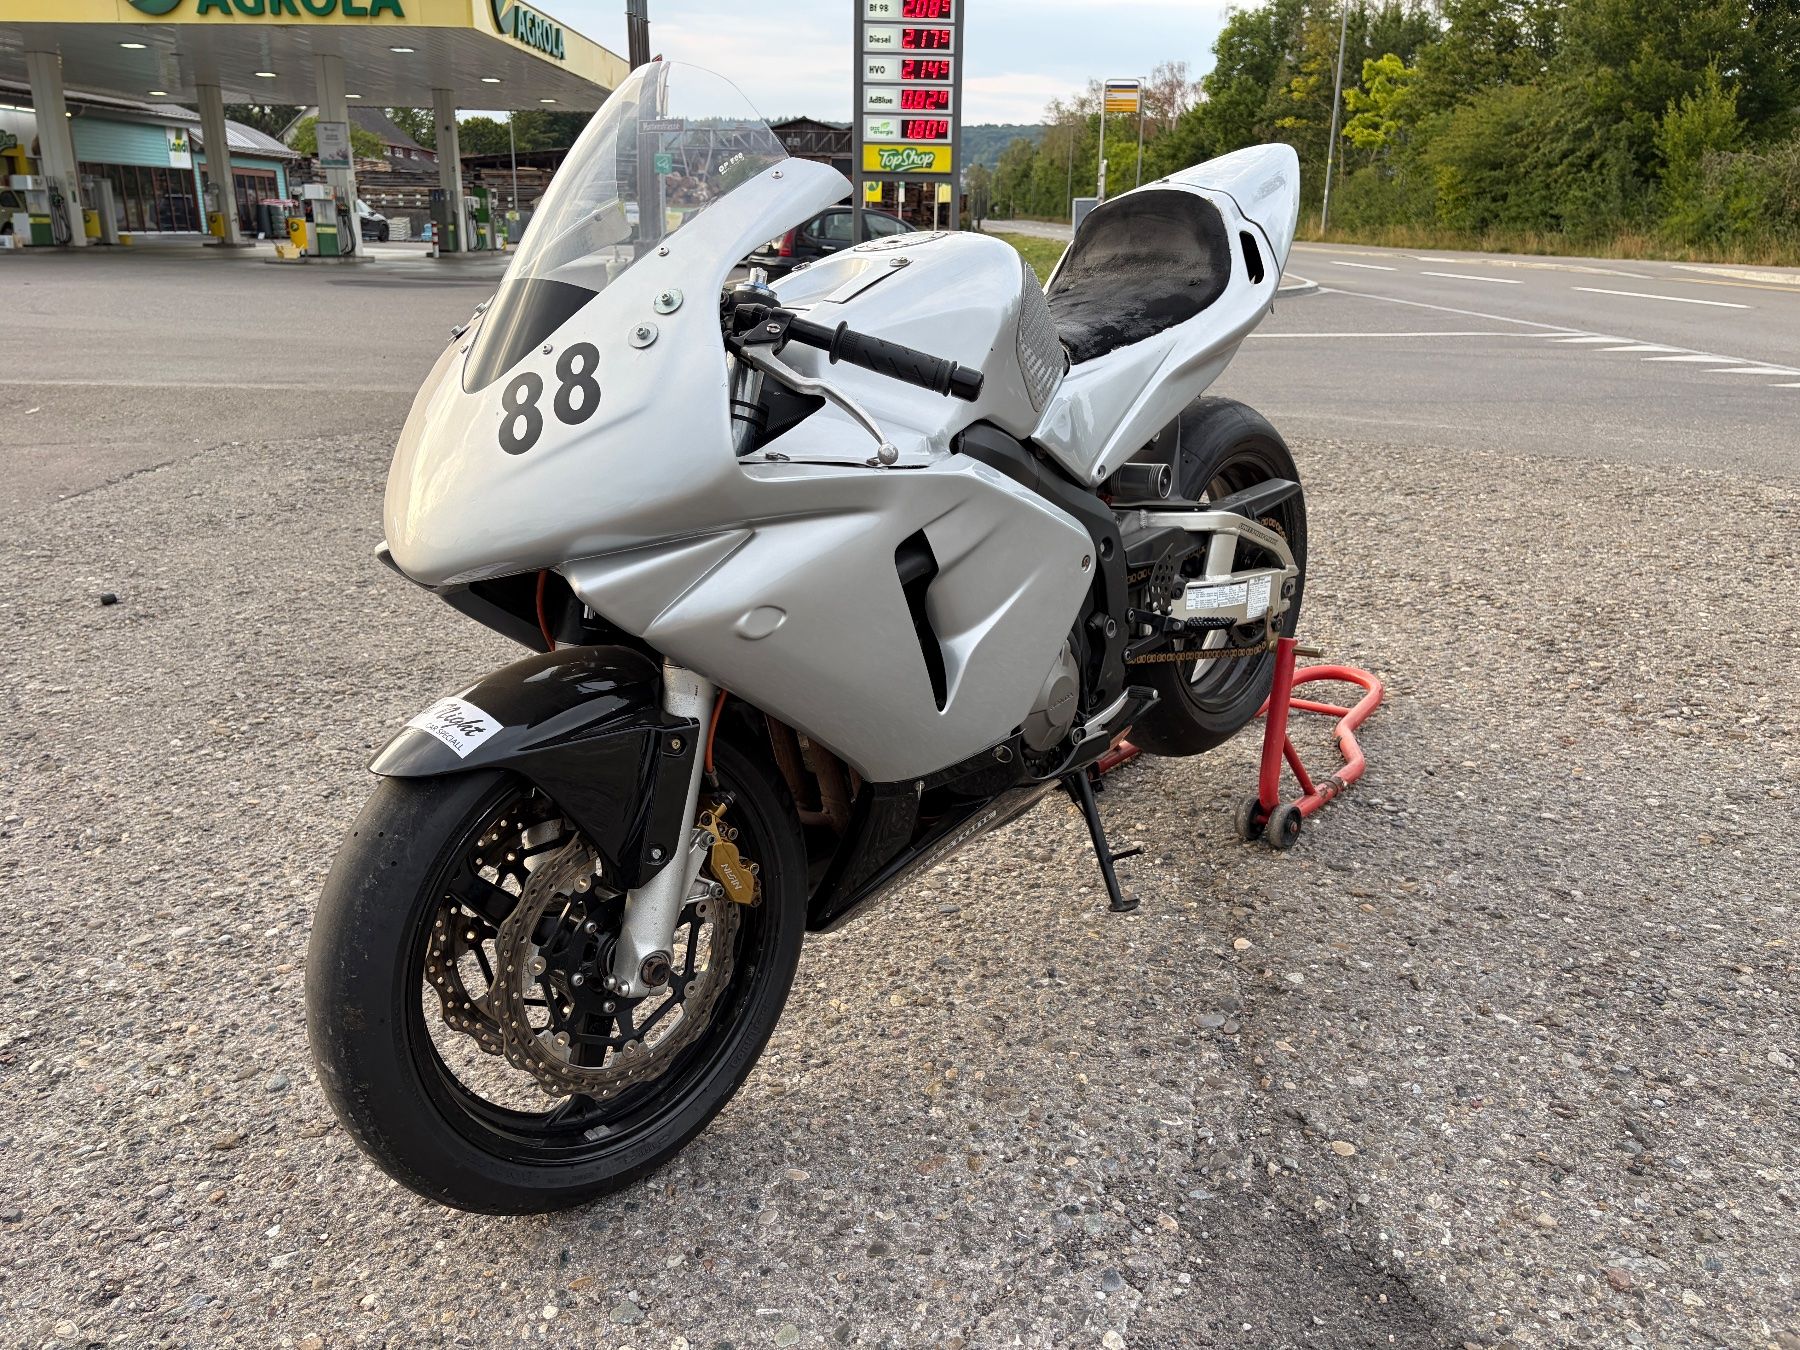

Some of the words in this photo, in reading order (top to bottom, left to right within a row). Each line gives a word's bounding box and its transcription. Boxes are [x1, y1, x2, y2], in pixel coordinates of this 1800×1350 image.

[879, 4, 889, 12] 98
[514, 5, 566, 60] AGROLA
[869, 35, 892, 44] Diesel
[869, 66, 885, 74] HVO
[868, 96, 893, 104] AdBlue
[168, 138, 189, 153] Landi
[434, 703, 487, 737] Night
[720, 863, 743, 890] NISSIN
